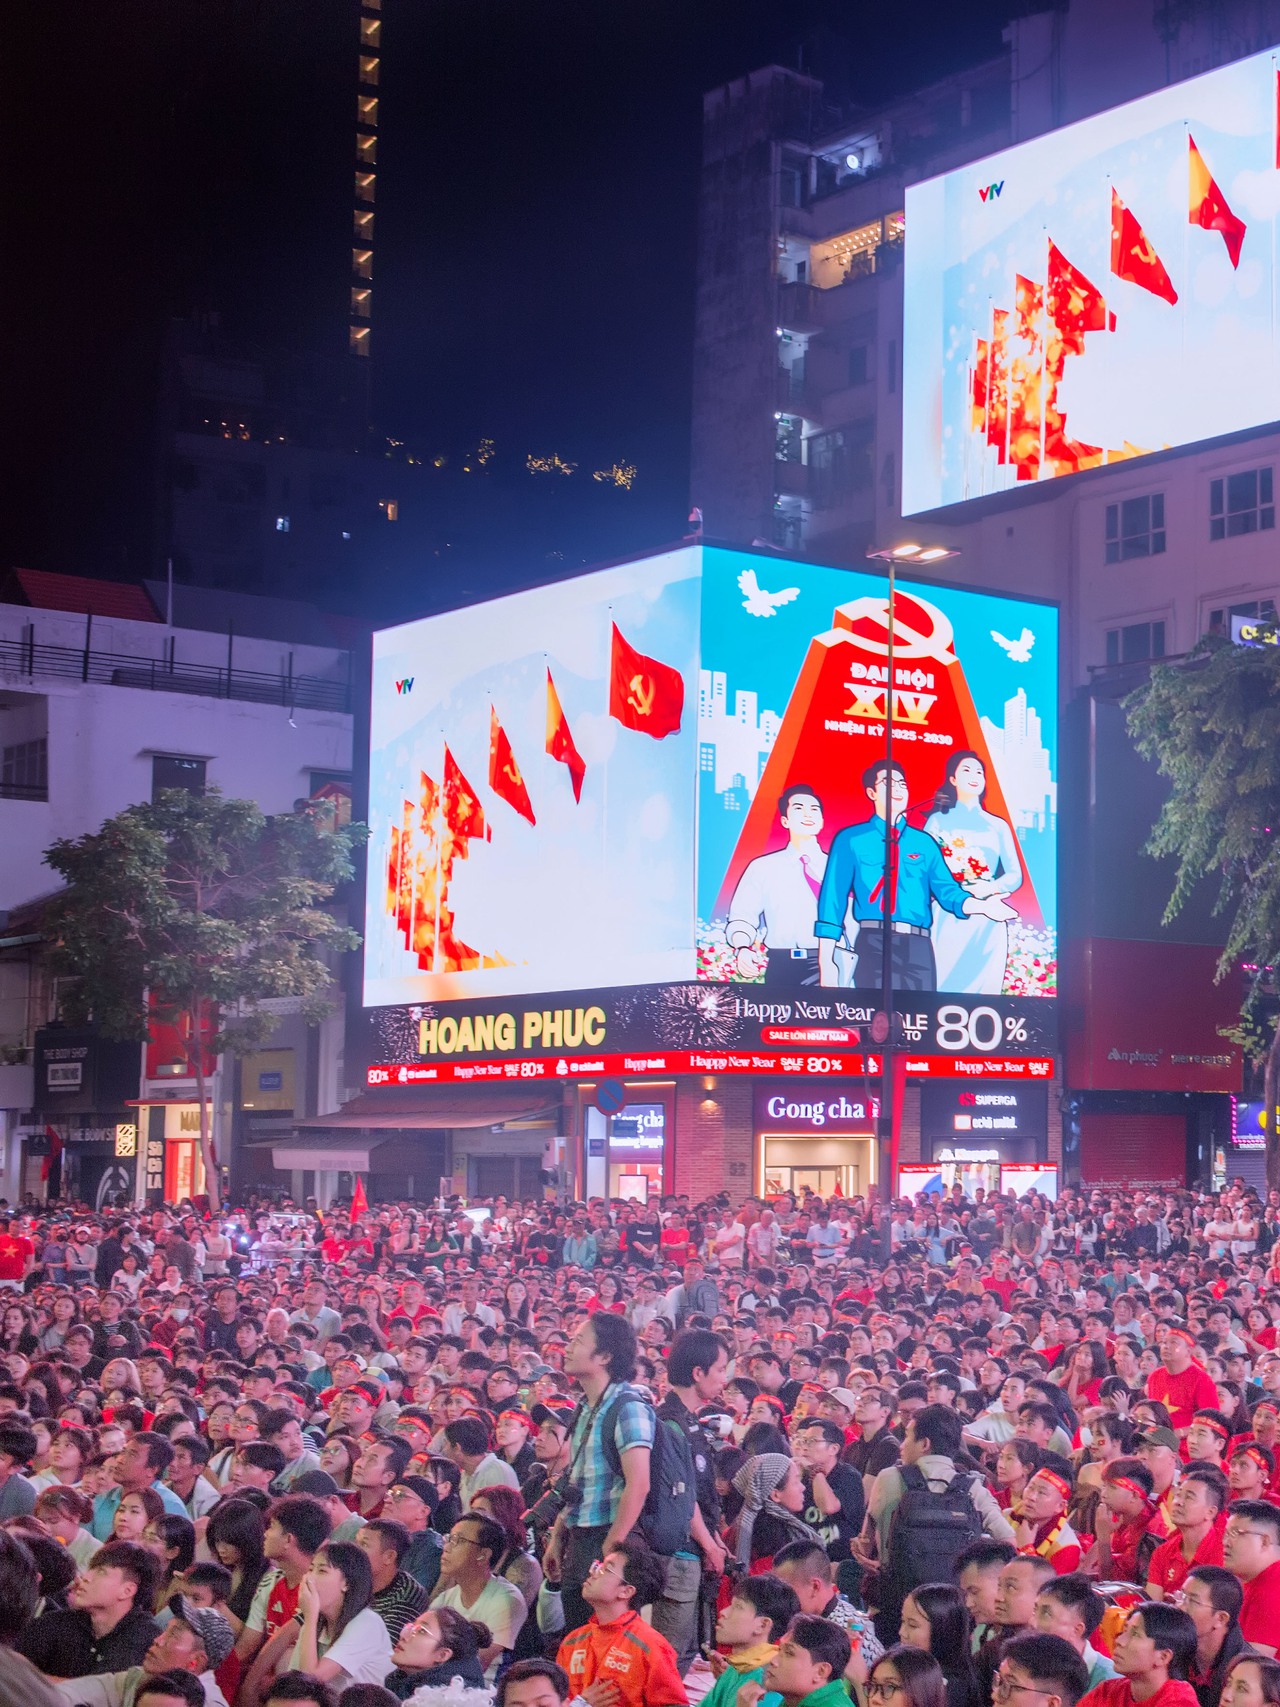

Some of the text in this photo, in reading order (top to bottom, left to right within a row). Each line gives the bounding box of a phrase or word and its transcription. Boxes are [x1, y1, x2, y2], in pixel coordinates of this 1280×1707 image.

[979, 180, 1004, 203] VTV
[850, 662, 934, 691] ĐẠI HỘI
[396, 677, 415, 695] VTV
[843, 682, 937, 726] XIV
[824, 719, 865, 736] NHIỆM
[868, 724, 885, 737] KỲ
[923, 732, 953, 746] 2030
[735, 998, 876, 1023] Happy New Year
[419, 1006, 606, 1055] HOANG PHUC
[769, 1031, 789, 1040] SALE
[690, 1055, 776, 1070] Happy New Year
[780, 1057, 804, 1066] SALE
[955, 1060, 984, 1075] Happy
[984, 1061, 1003, 1072] New
[1004, 1062, 1025, 1073] Year
[1028, 1062, 1049, 1071] SALE
[975, 1094, 1018, 1106] SUPERGA
[643, 1110, 664, 1128] cha
[767, 1096, 825, 1126] Gong
[828, 1096, 865, 1119] cha
[604, 1655, 631, 1673] Food
